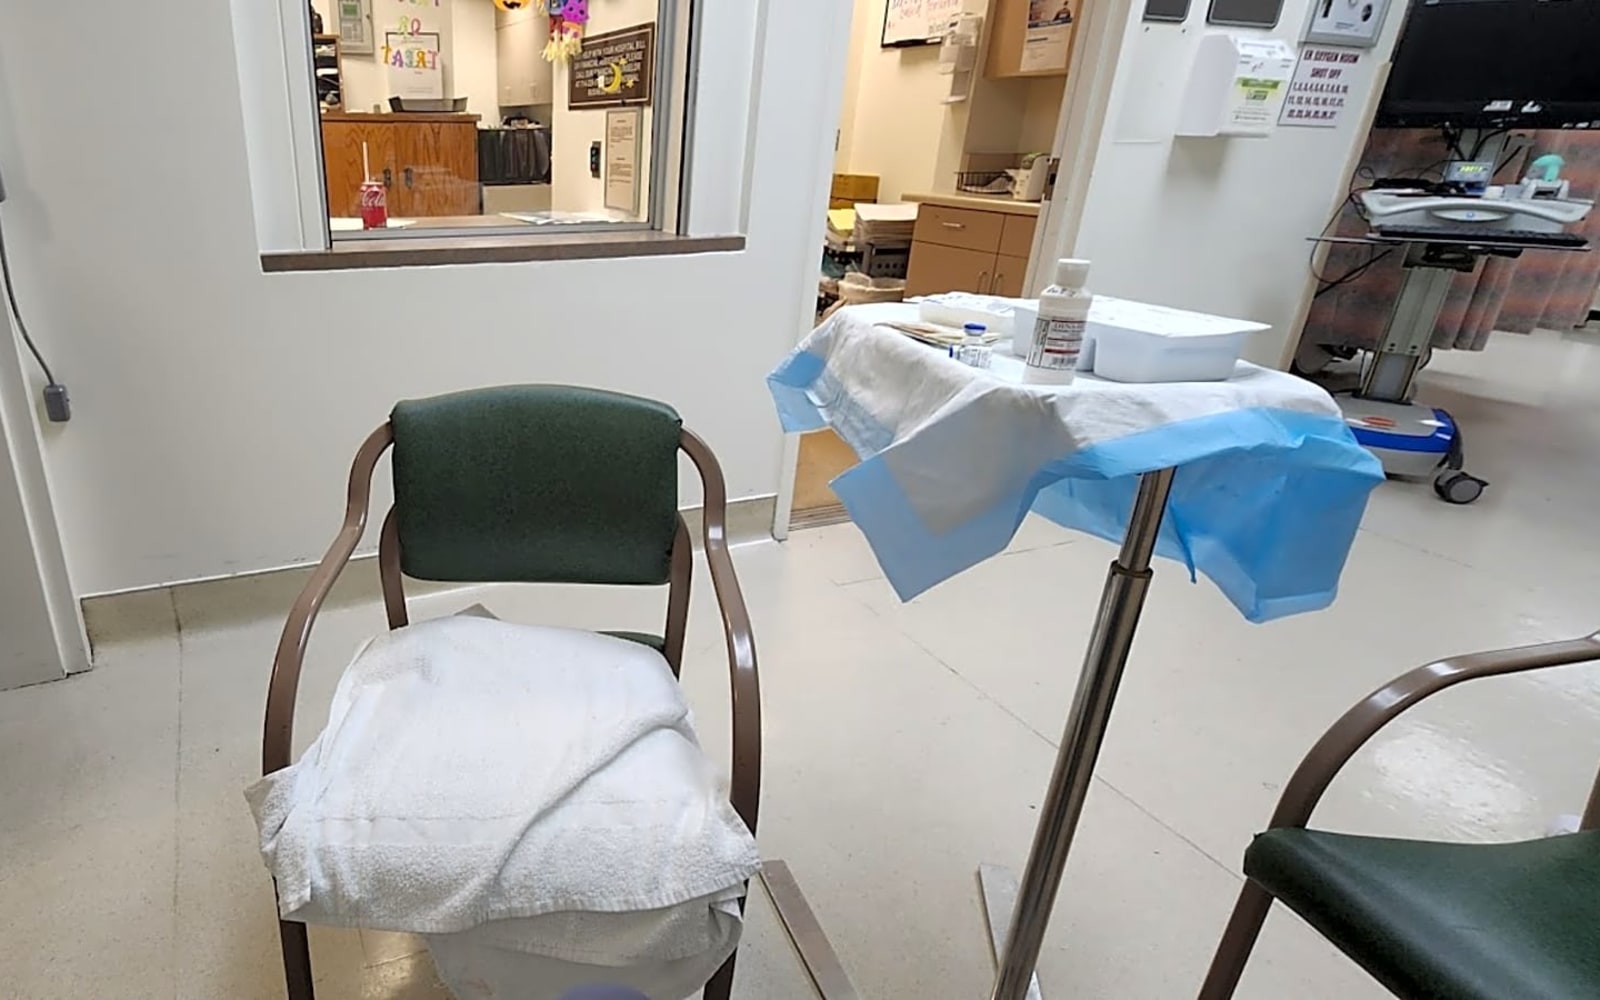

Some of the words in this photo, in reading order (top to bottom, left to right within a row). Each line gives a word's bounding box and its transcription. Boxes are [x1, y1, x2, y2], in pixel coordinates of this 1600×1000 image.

[1303, 50, 1313, 60] ER
[1314, 50, 1339, 62] OXYGEN
[1339, 52, 1360, 64] ROOM
[1310, 67, 1329, 78] SHUT
[1328, 68, 1343, 79] OFF
